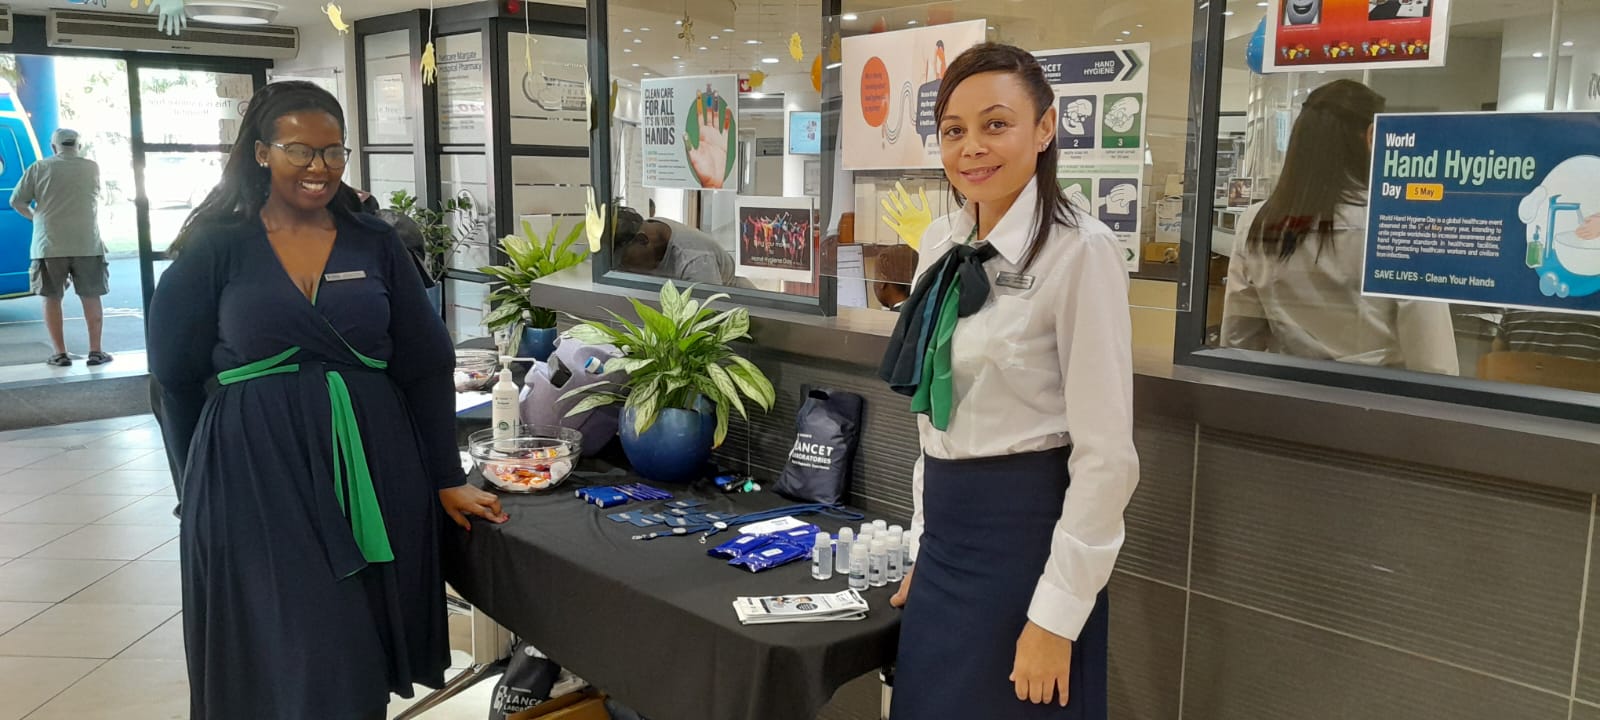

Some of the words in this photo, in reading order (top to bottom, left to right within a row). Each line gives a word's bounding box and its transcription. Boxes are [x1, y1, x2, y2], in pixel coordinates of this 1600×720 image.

[458, 63, 482, 72] Pharmacy
[1041, 64, 1062, 72] NCET
[1084, 68, 1115, 76] HYGIENE
[645, 88, 660, 99] CLEAN
[660, 88, 674, 98] CARE
[645, 100, 659, 116] FOR
[660, 100, 674, 115] ALL
[655, 117, 660, 126] IN
[660, 116, 675, 126] YOUR
[645, 127, 675, 145] HANDS
[1386, 133, 1415, 147] World
[1073, 139, 1079, 147] 2
[1117, 138, 1123, 146] 3
[1383, 150, 1438, 178] Hand
[1444, 150, 1536, 185] Hygiene
[1382, 183, 1401, 199] Day
[1420, 188, 1434, 197] May
[1374, 270, 1394, 279] SAVE
[1396, 270, 1418, 281] LIVES
[1425, 273, 1447, 283] Clean
[1449, 275, 1467, 285] Your
[1469, 276, 1495, 287] Hands
[794, 442, 834, 456] ANCET
[506, 695, 542, 706] LANC
